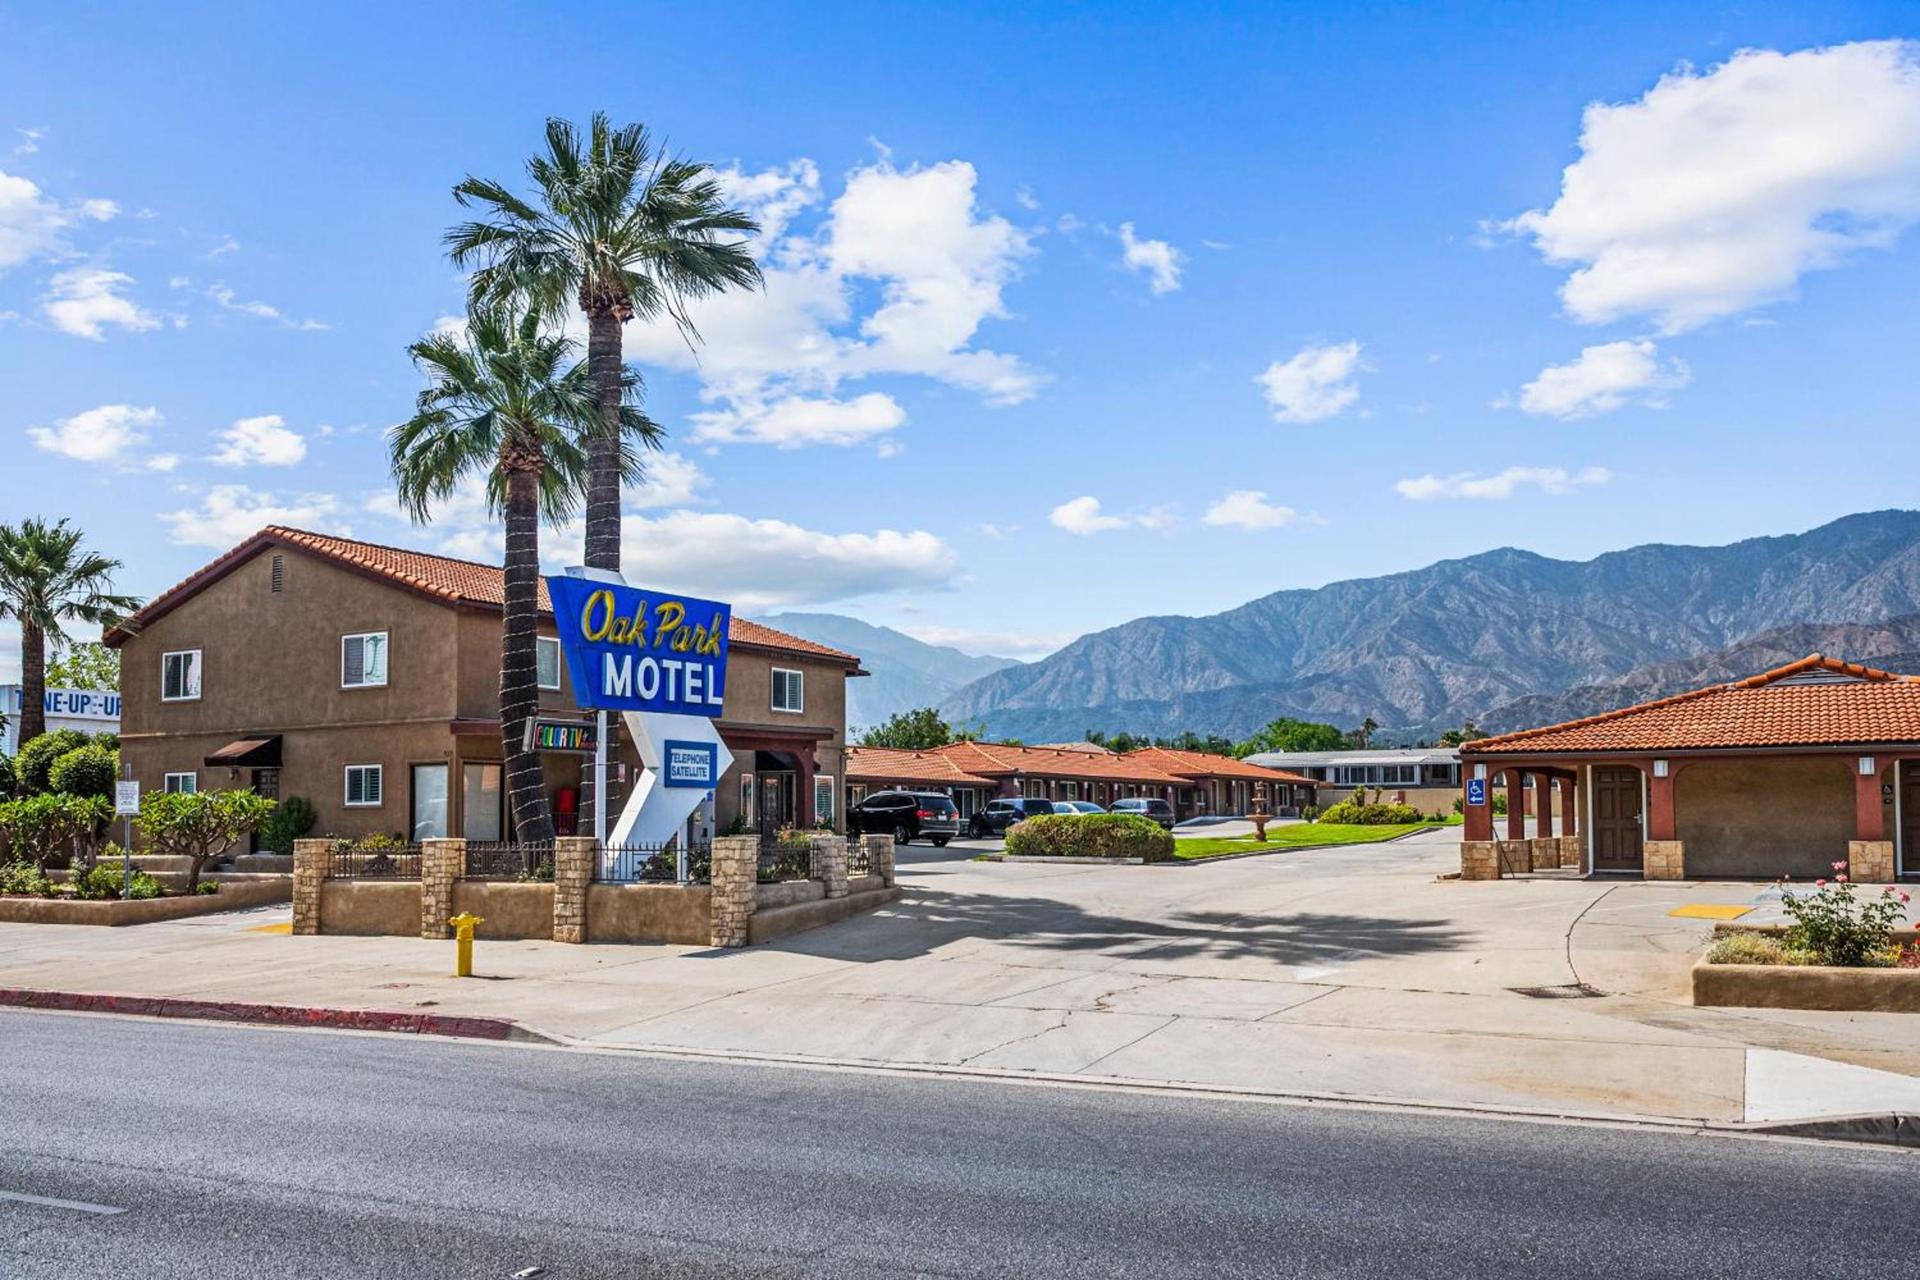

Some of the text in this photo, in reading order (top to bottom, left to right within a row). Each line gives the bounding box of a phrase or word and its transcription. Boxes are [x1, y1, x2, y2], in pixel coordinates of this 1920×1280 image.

[581, 589, 723, 657] Oak Park
[602, 652, 723, 705] MOTEL
[15, 690, 91, 714] TNE-UP
[534, 725, 583, 749] COLOR TV
[671, 766, 707, 777] SATELLITE
